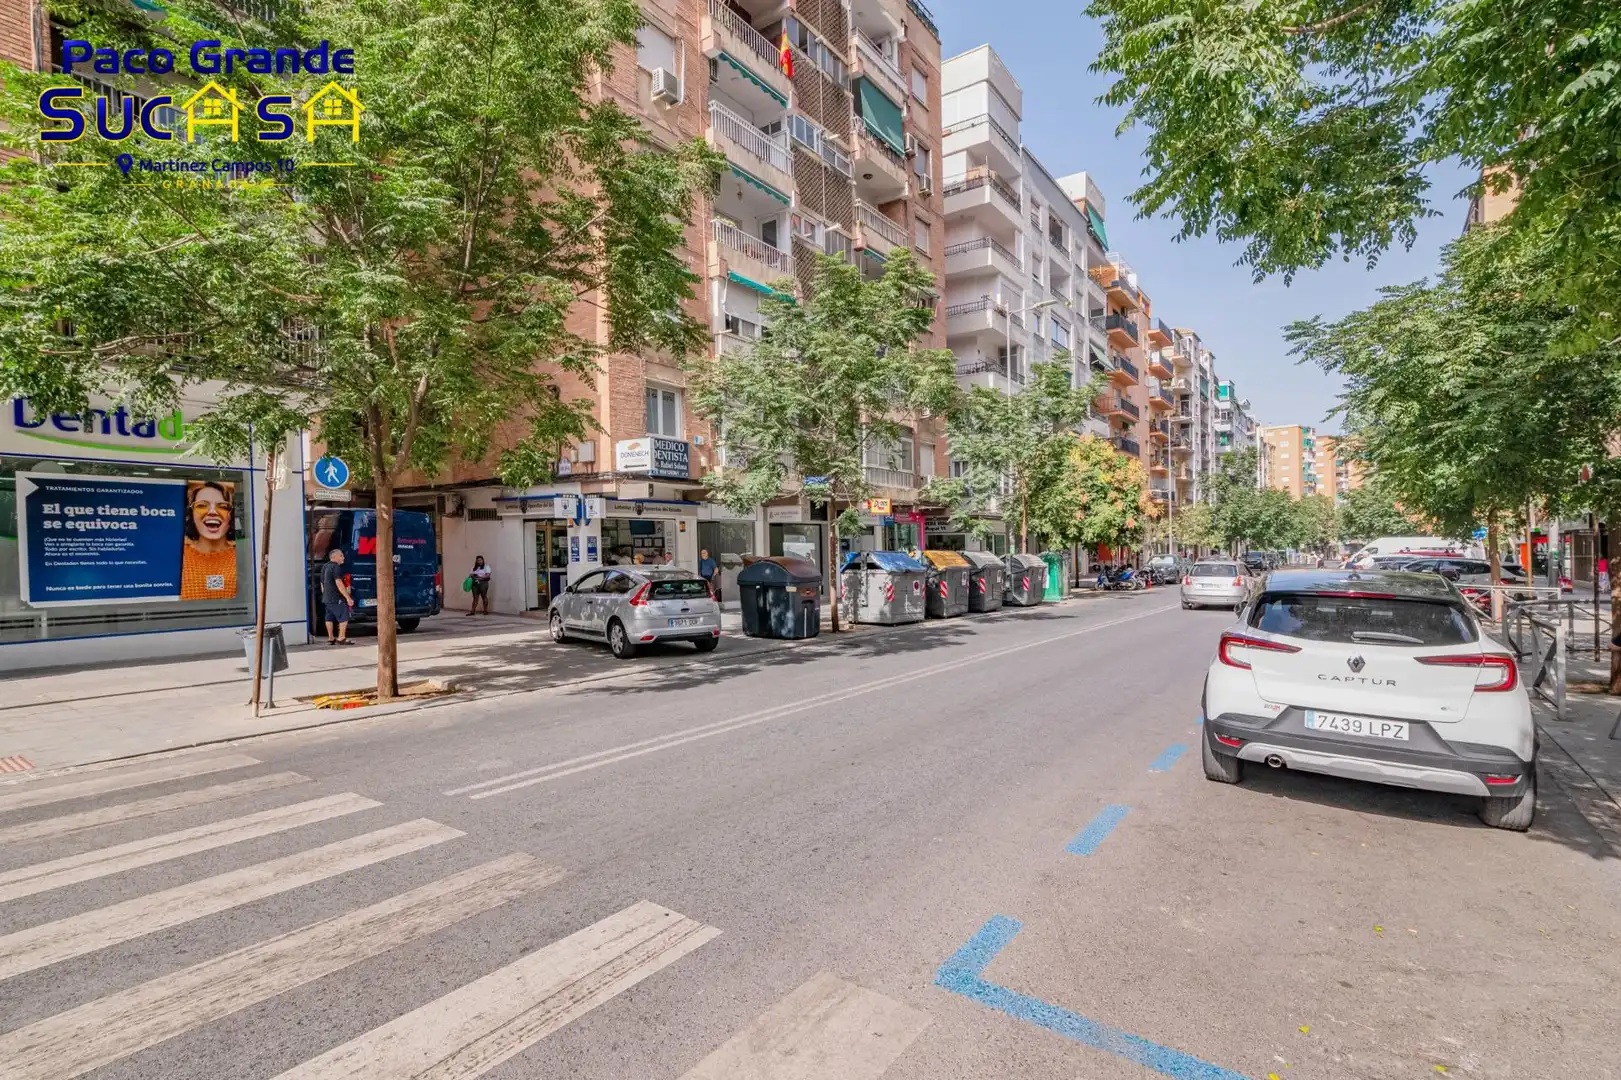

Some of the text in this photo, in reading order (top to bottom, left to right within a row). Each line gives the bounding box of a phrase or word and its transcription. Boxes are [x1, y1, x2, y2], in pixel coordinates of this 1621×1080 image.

[653, 450, 689, 463] DENTISTA
[45, 485, 144, 495] TRATAMIENTOS GARANTIZADOS
[42, 503, 176, 517] El que tiene boca
[43, 518, 138, 532] se equivoca
[1317, 673, 1398, 688] CAPTUR
[1318, 714, 1404, 740] 7439 LPZ
